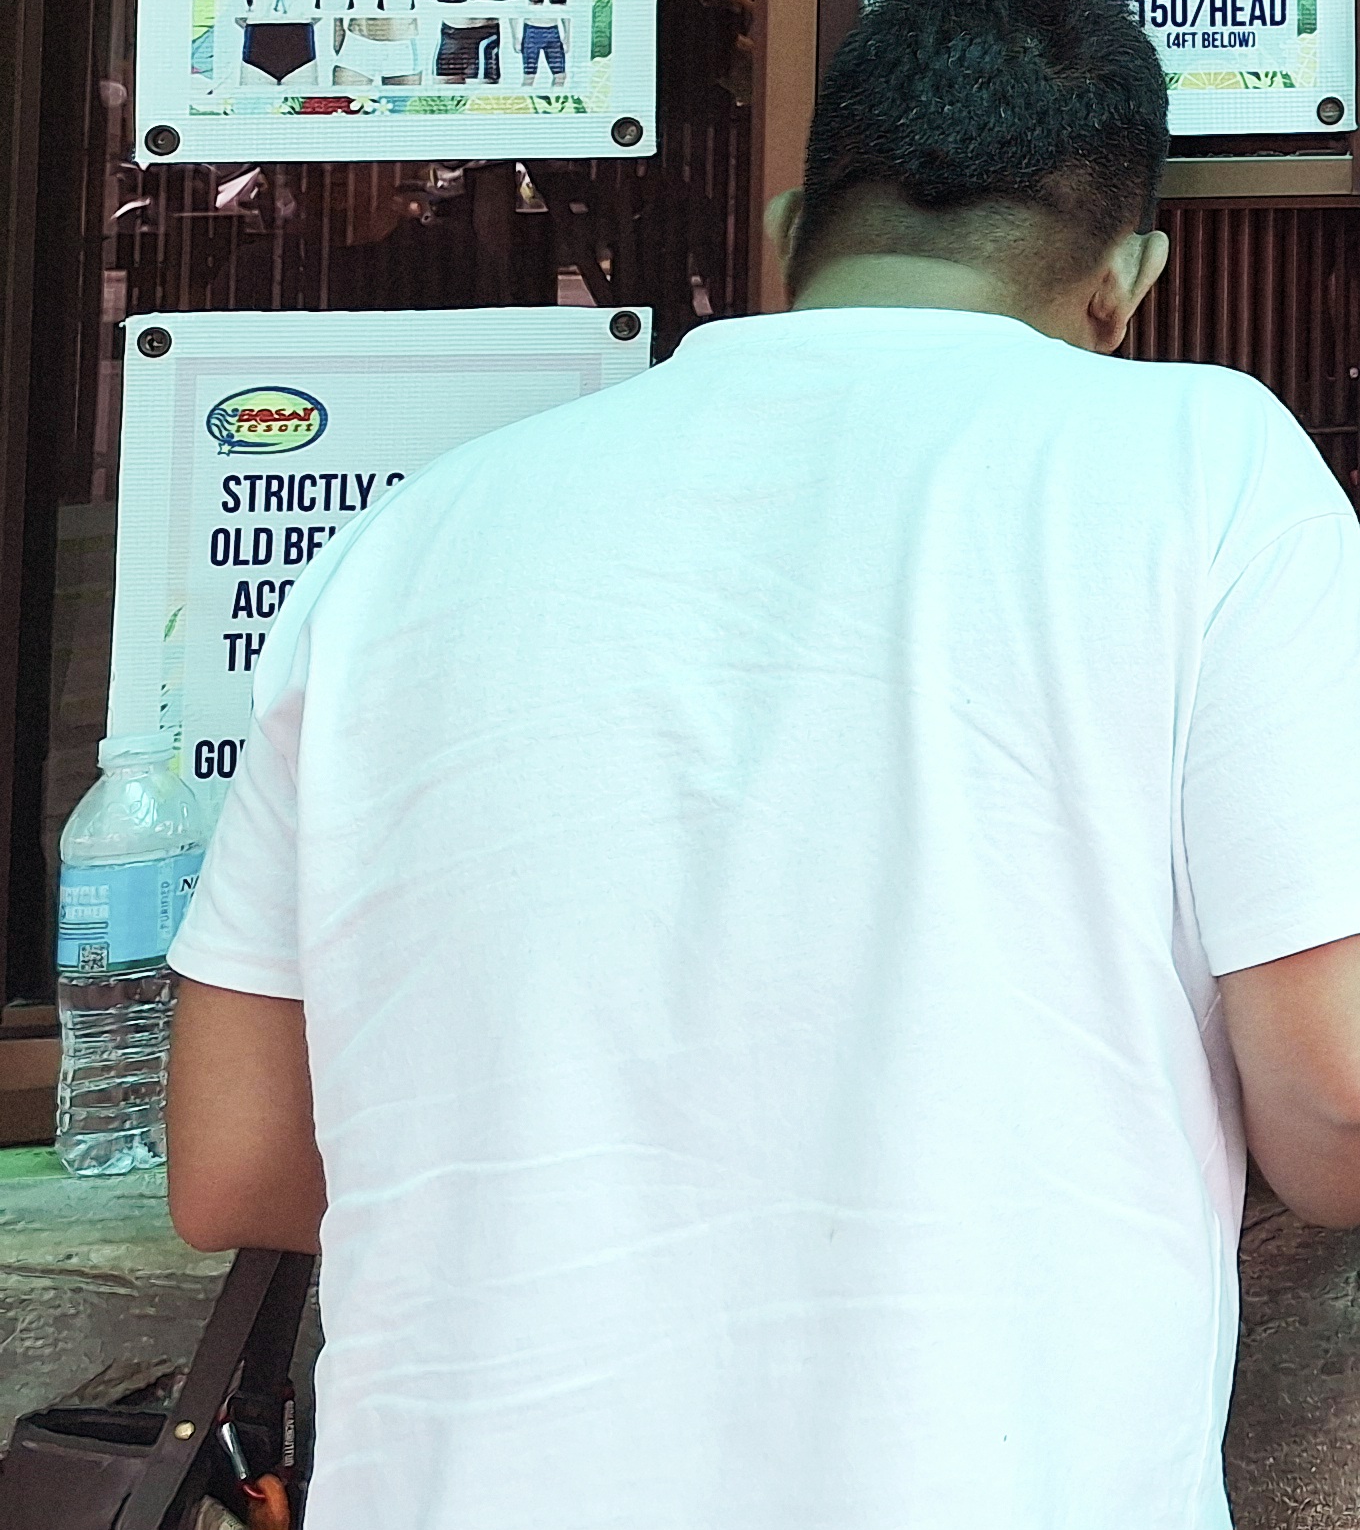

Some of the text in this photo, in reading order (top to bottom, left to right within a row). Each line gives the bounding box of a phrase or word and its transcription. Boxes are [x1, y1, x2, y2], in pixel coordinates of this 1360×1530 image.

[1167, 32, 1255, 49] (4FT BELOW)
[222, 474, 375, 513] STRICTLY
[211, 528, 273, 566] OLD
